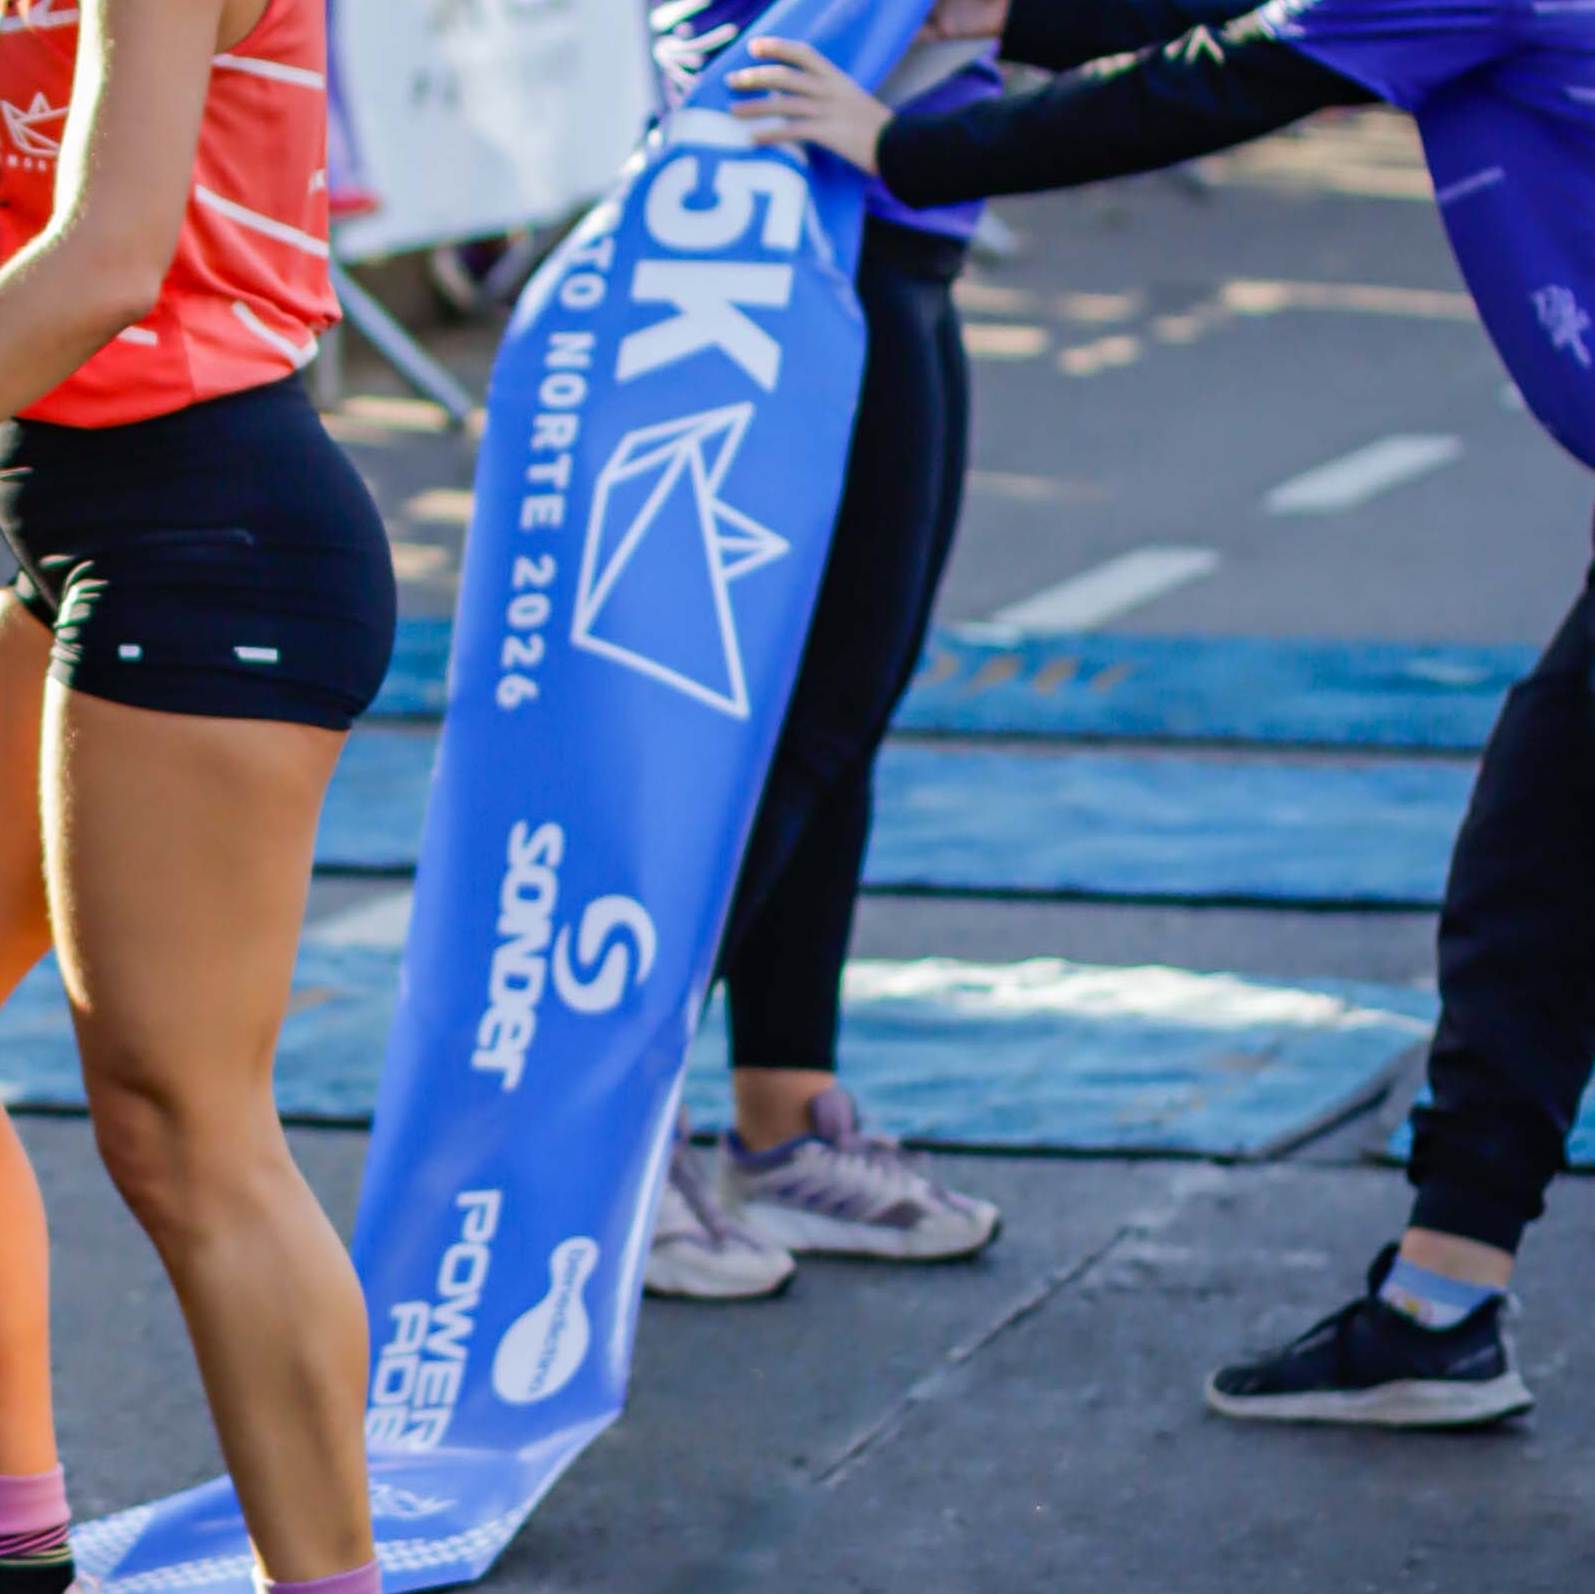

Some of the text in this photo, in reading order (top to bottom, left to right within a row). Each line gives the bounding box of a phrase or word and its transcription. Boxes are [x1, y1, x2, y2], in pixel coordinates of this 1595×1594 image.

[522, 331, 596, 530] NORTE
[497, 555, 556, 711] 2026
[408, 1189, 501, 1452] POWER
